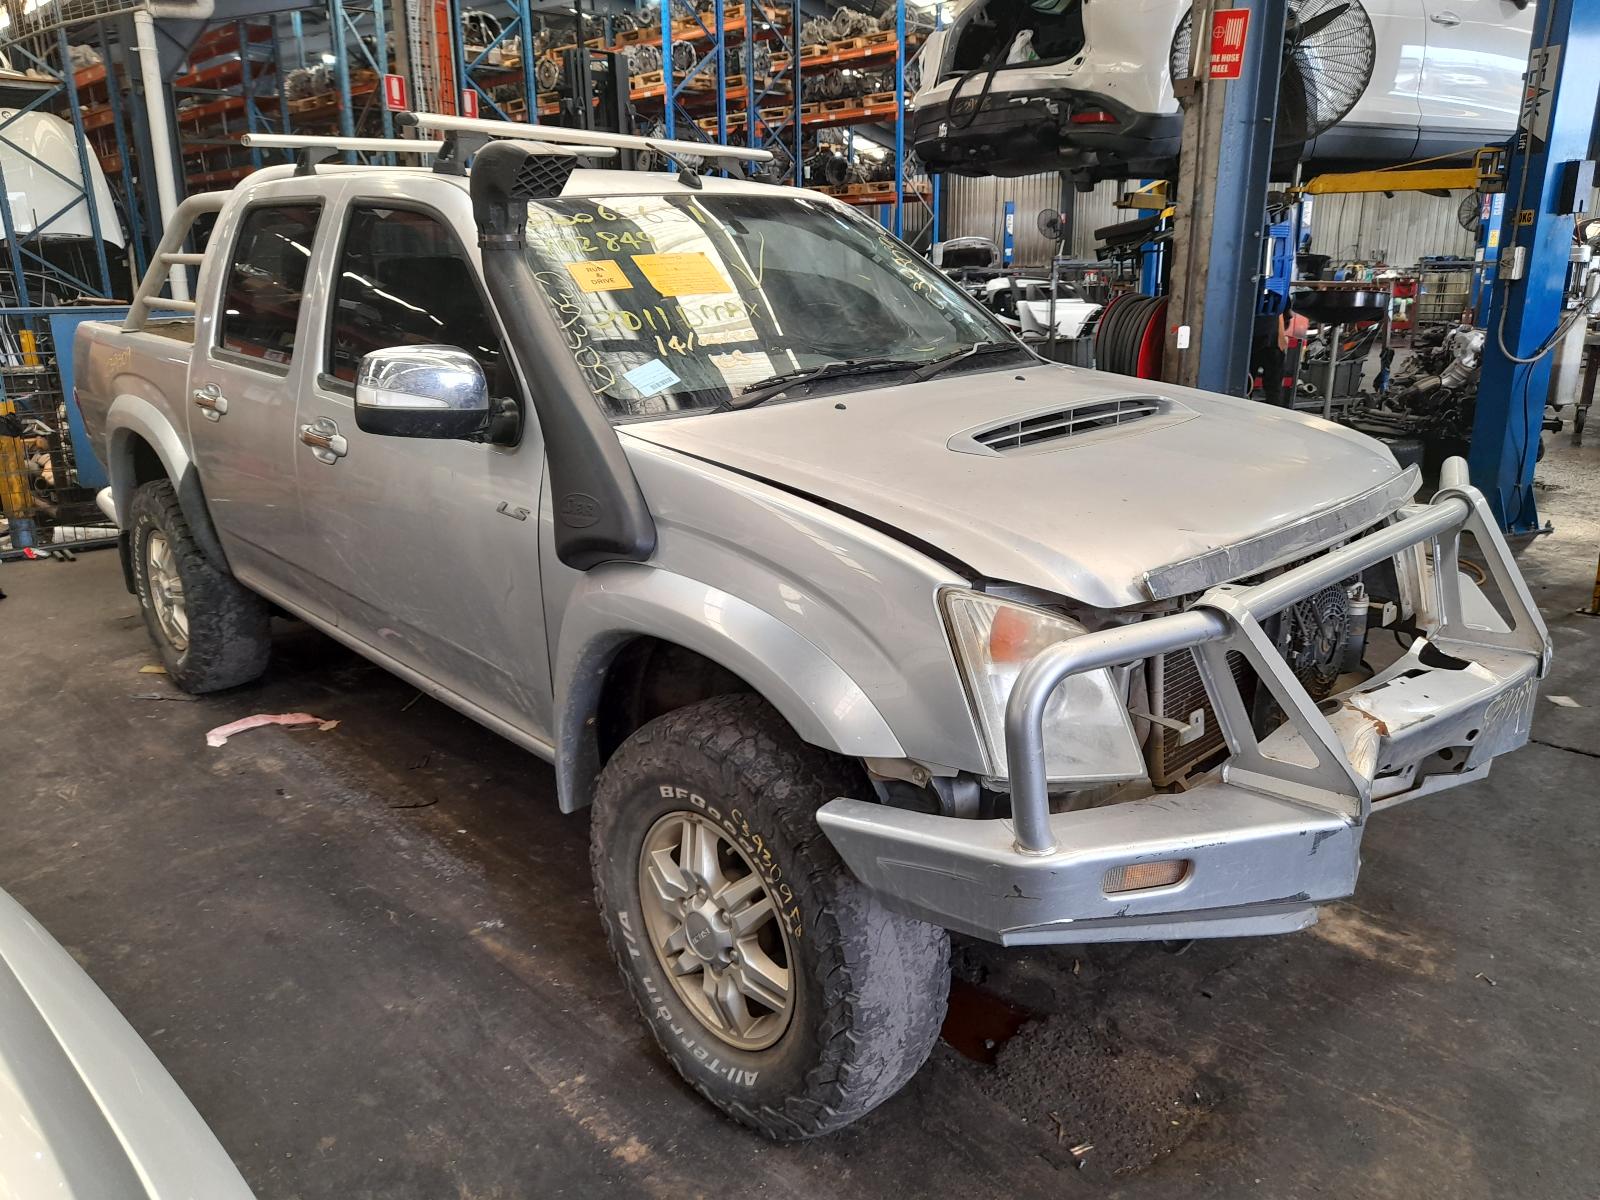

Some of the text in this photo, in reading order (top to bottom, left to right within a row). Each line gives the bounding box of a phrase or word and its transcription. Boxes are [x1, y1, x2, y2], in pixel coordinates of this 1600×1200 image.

[1221, 54, 1240, 62] HOSE
[1211, 64, 1228, 72] REEL
[590, 277, 616, 286] DRIVE
[496, 501, 531, 522] LS
